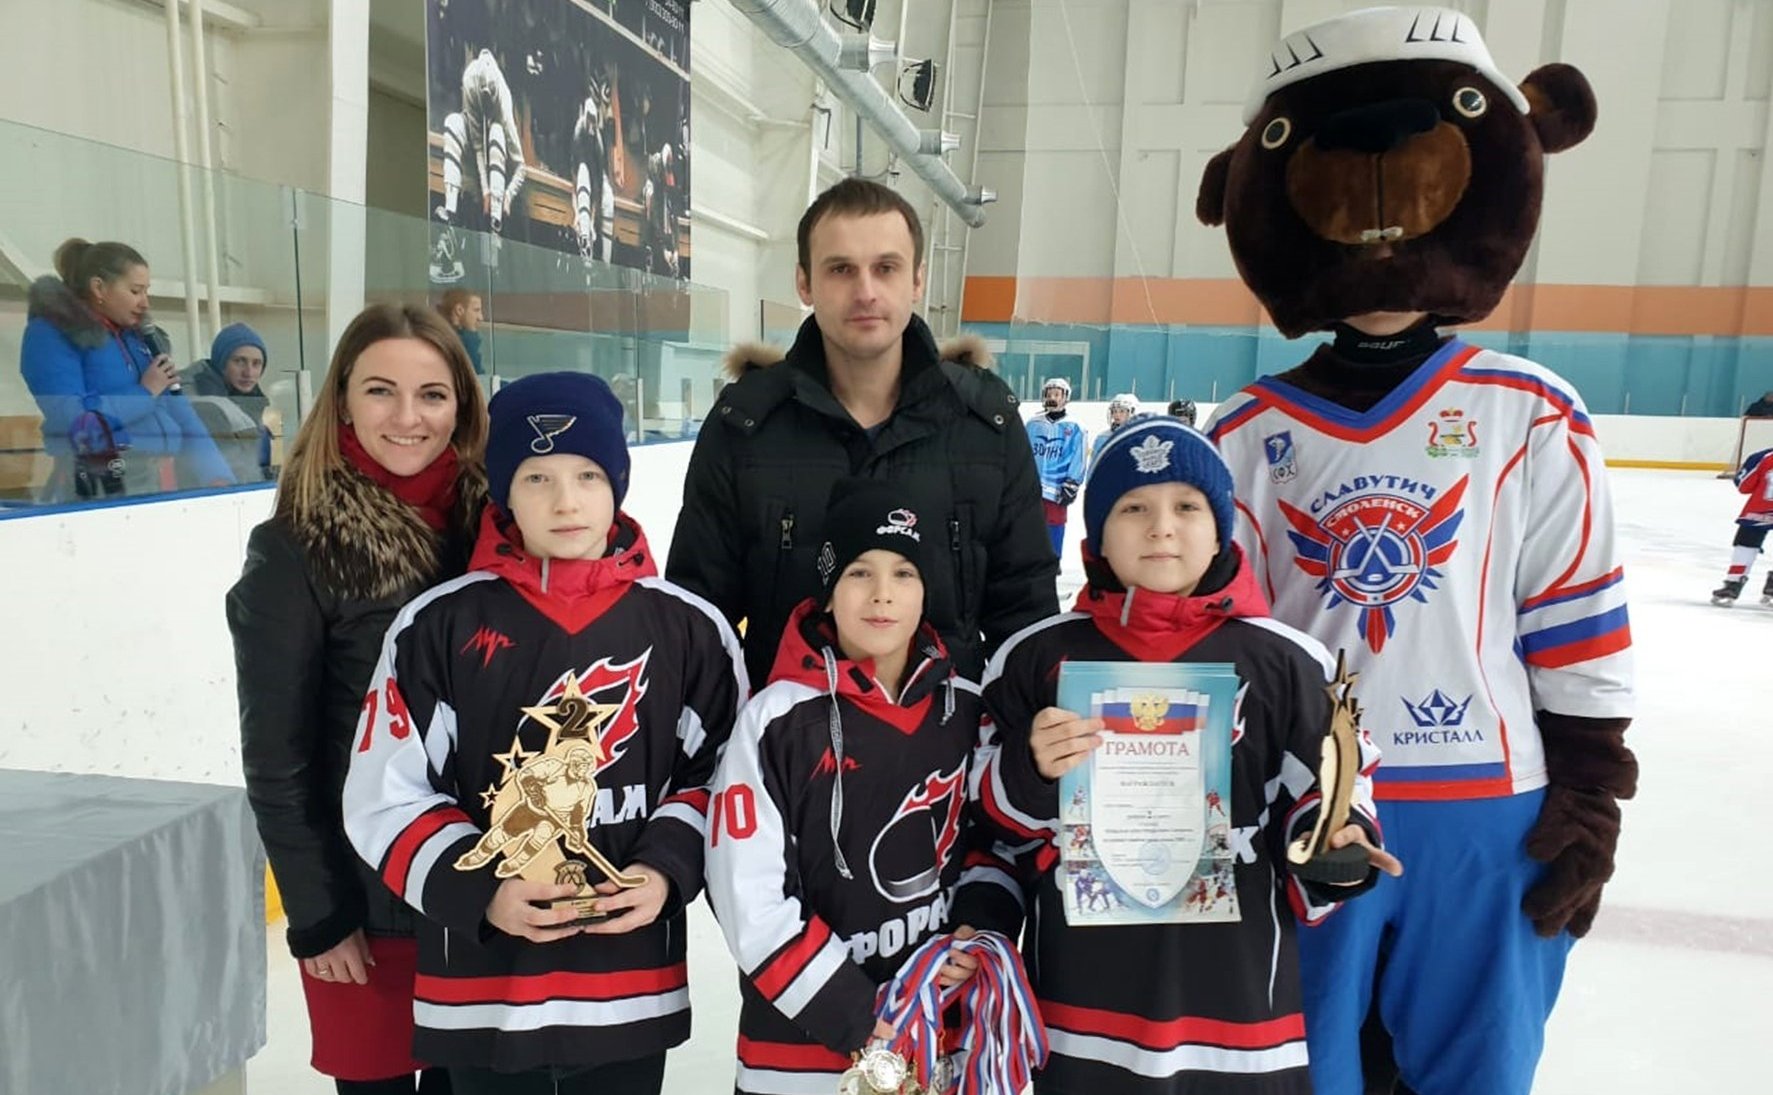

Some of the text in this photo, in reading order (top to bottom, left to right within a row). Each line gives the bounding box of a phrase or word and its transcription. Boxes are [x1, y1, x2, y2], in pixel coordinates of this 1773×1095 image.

[1310, 475, 1437, 514] СЛАВУТИЧ
[1325, 498, 1421, 528] СМОЛЕНСК
[357, 676, 411, 753] 79
[556, 697, 590, 740] 2
[1105, 740, 1190, 756] ГРАМОТА
[1393, 729, 1484, 745] КРИСТАЛЛ
